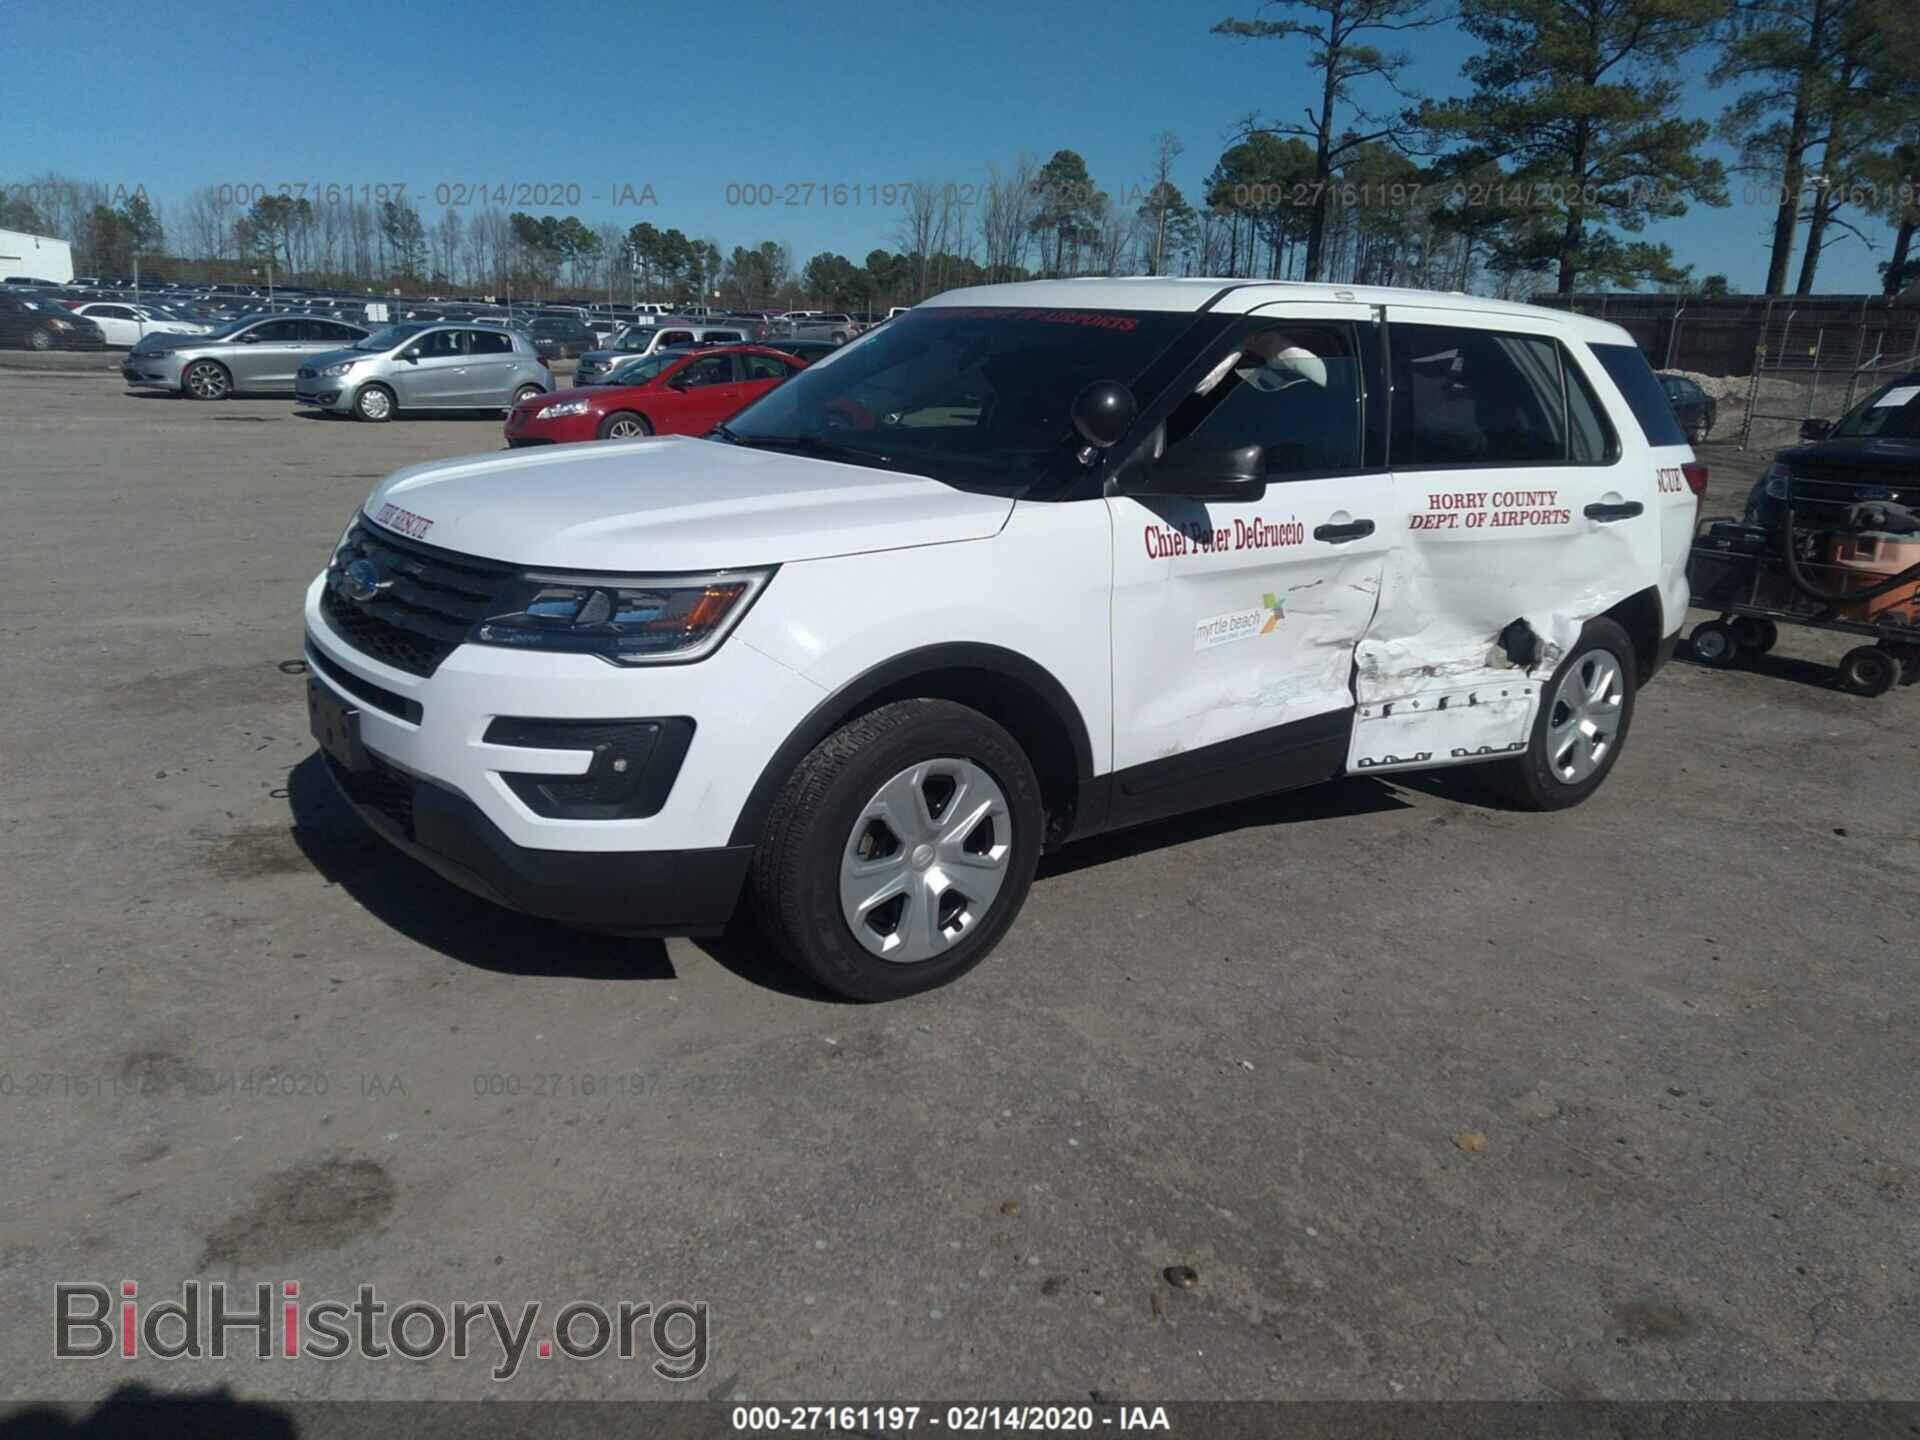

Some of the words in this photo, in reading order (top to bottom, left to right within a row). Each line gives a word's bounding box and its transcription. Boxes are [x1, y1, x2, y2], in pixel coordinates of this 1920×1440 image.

[1428, 492, 1488, 510] HORRY
[1492, 490, 1558, 508] COUNTY
[1408, 513, 1459, 530] DEPT.
[1465, 512, 1488, 529] OF
[1490, 508, 1571, 528] AIRPORTS
[1145, 520, 1188, 559] Chief
[1190, 519, 1231, 554] Peter
[1234, 515, 1304, 550] DeGruccio
[1229, 609, 1261, 632] beach
